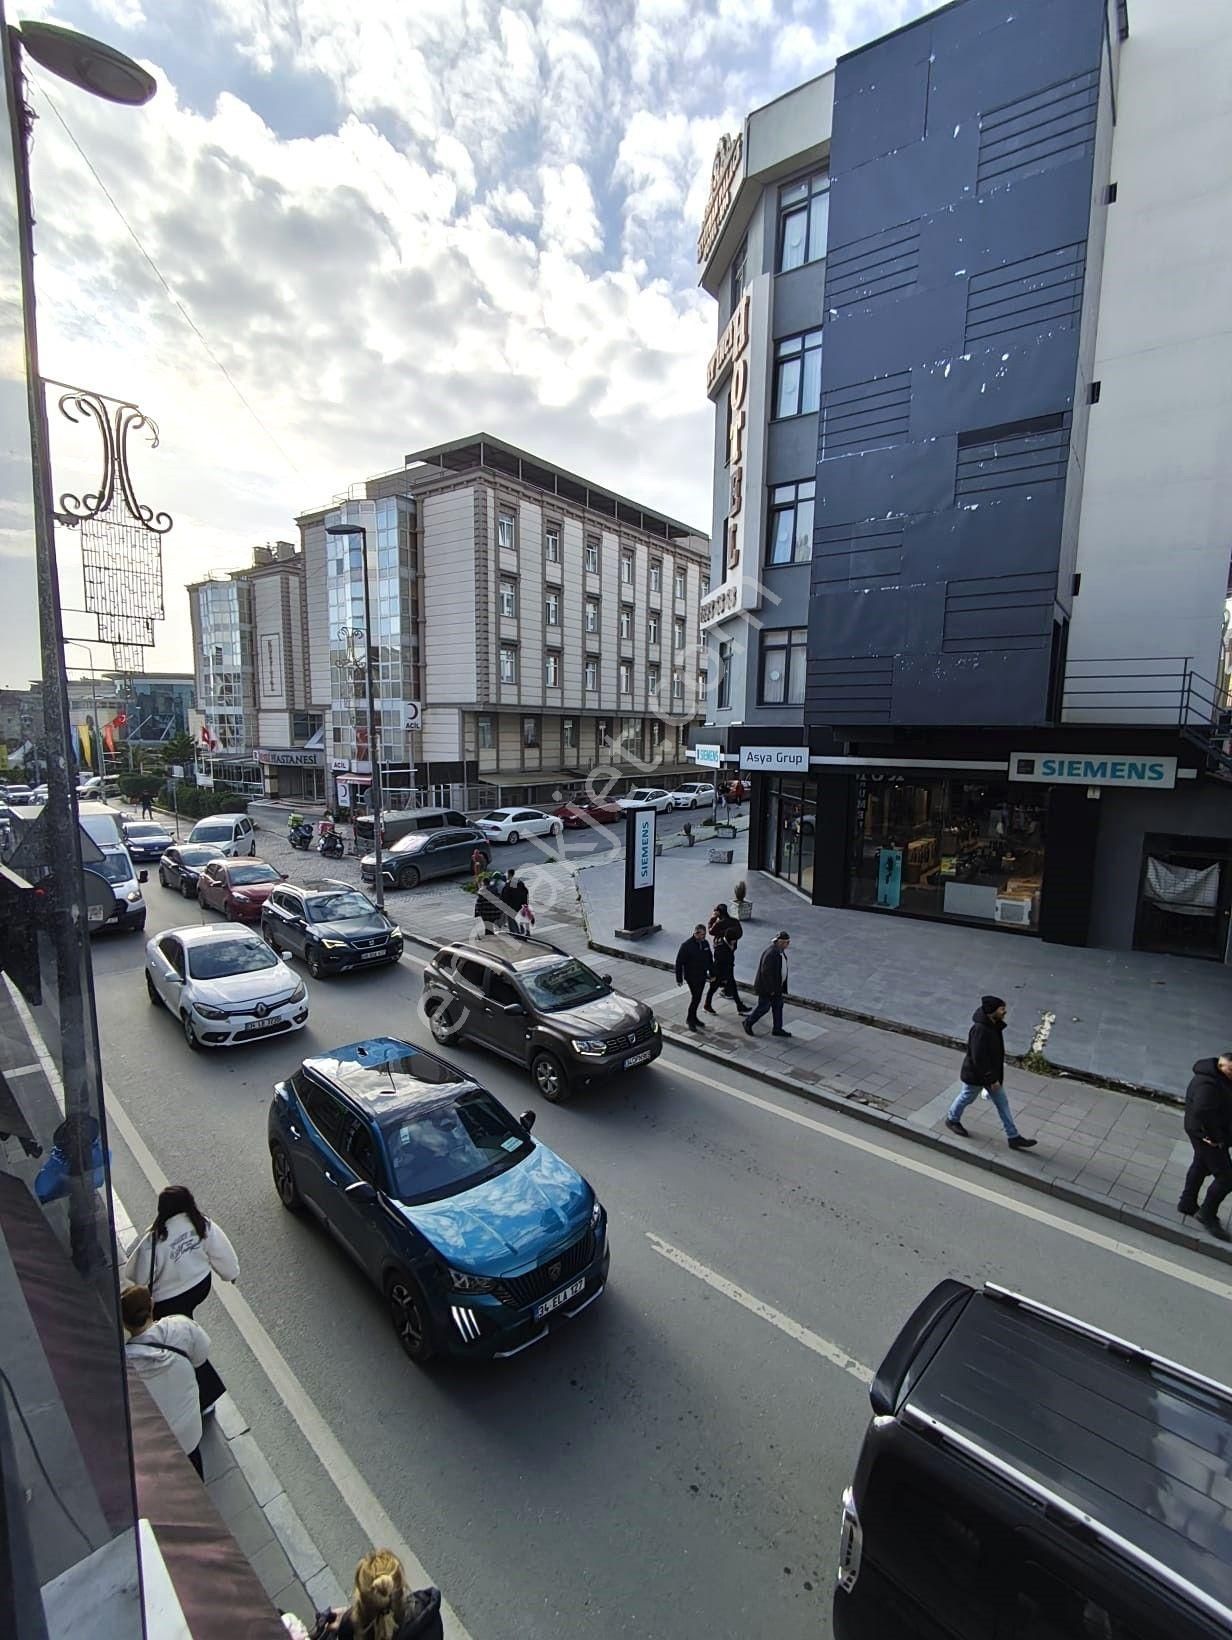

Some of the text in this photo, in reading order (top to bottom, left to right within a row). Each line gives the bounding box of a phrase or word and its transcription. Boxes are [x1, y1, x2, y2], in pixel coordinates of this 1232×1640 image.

[746, 751, 803, 766] Asya Grup
[1041, 759, 1165, 781] SIEMENS
[641, 821, 649, 877] SIEMENS
[552, 1291, 568, 1307] ELA
